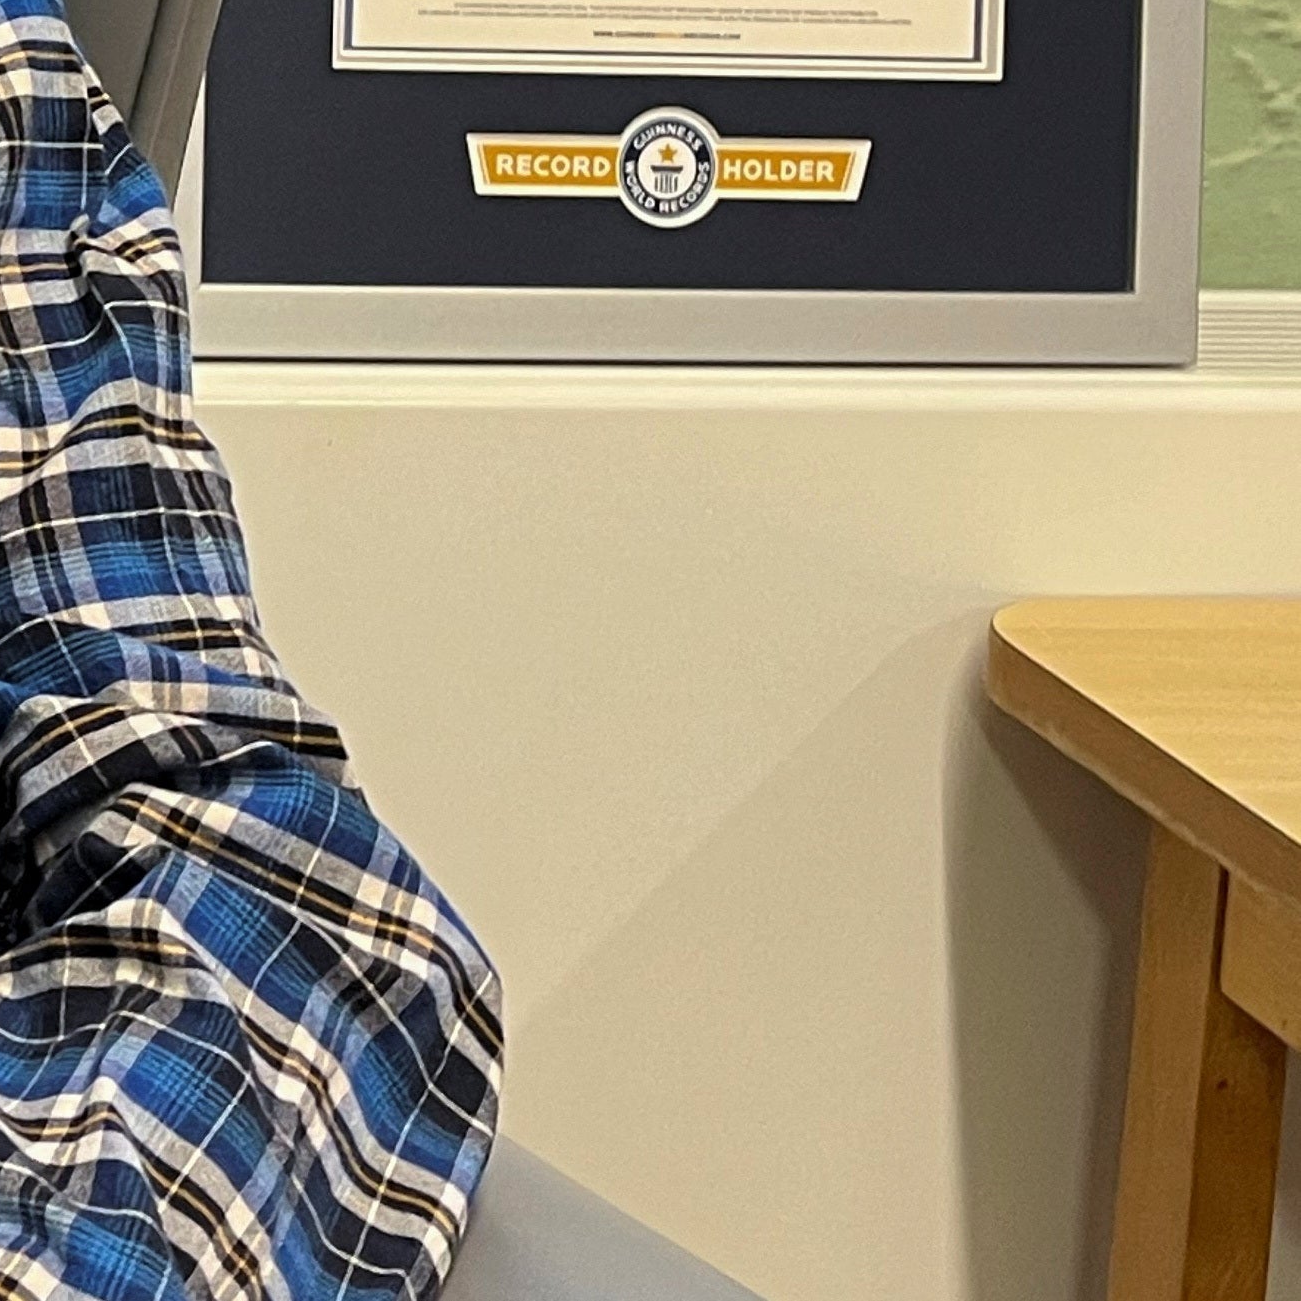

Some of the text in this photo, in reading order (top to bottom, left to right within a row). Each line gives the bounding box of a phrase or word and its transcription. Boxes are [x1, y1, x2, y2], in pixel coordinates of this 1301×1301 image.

[633, 123, 704, 151] GUINNESS
[496, 153, 836, 183] RECORD HOLDER
[624, 160, 711, 214] WORLD RECORDS
